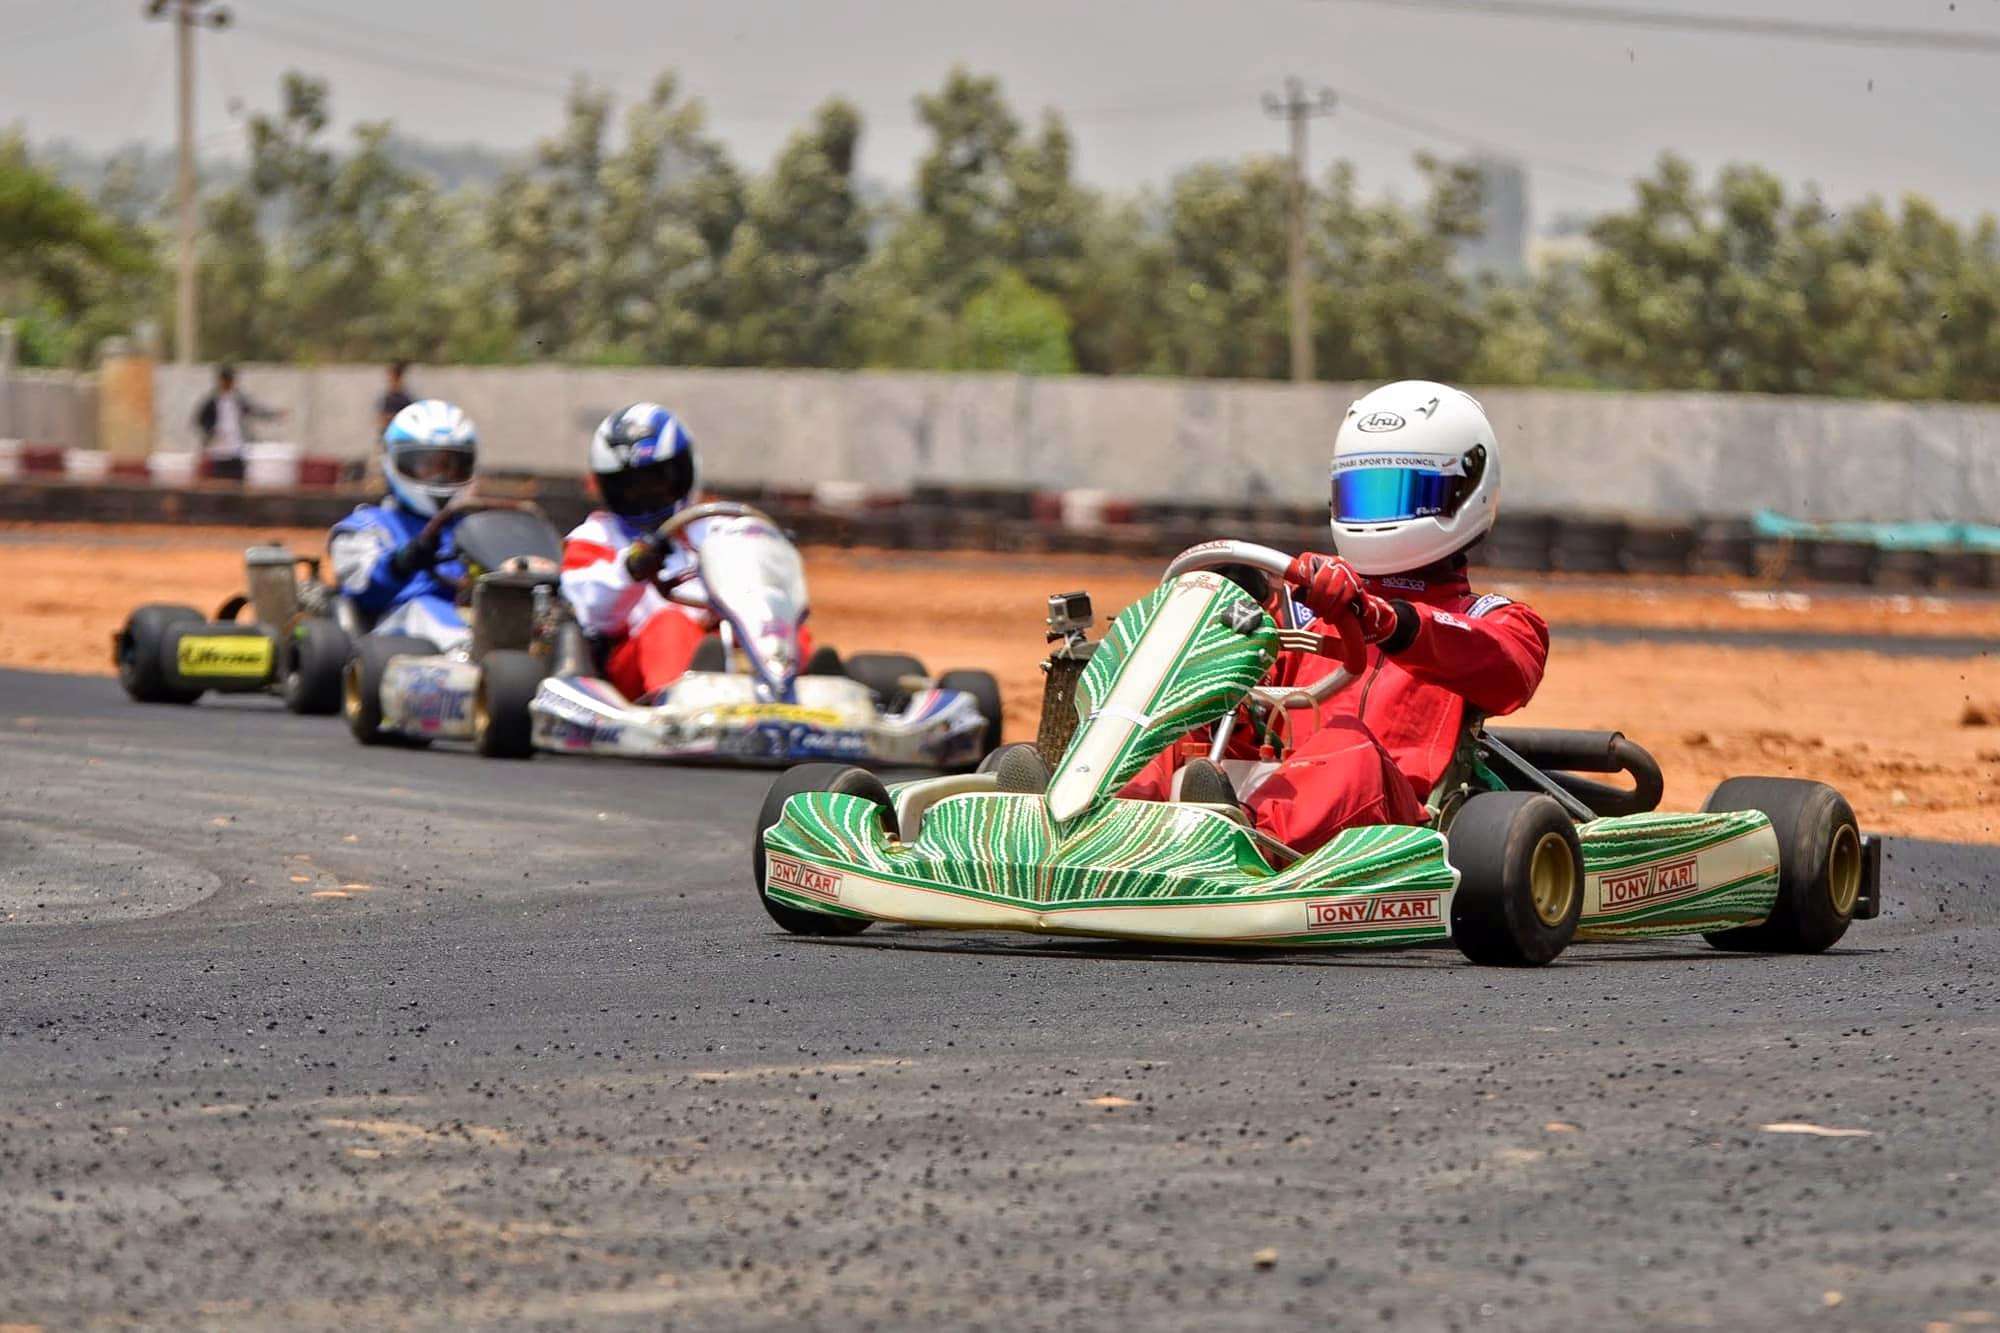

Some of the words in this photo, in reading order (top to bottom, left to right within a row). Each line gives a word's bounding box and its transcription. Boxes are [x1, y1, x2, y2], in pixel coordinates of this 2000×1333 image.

[1359, 457, 1392, 466] SPORTS
[1395, 457, 1436, 467] COUNCIL
[771, 858, 799, 884] TONY
[804, 868, 841, 895] KART
[1601, 870, 1648, 902] TONY
[1658, 859, 1696, 891] KART
[1309, 902, 1367, 922] TONY
[1381, 897, 1438, 919] KART
